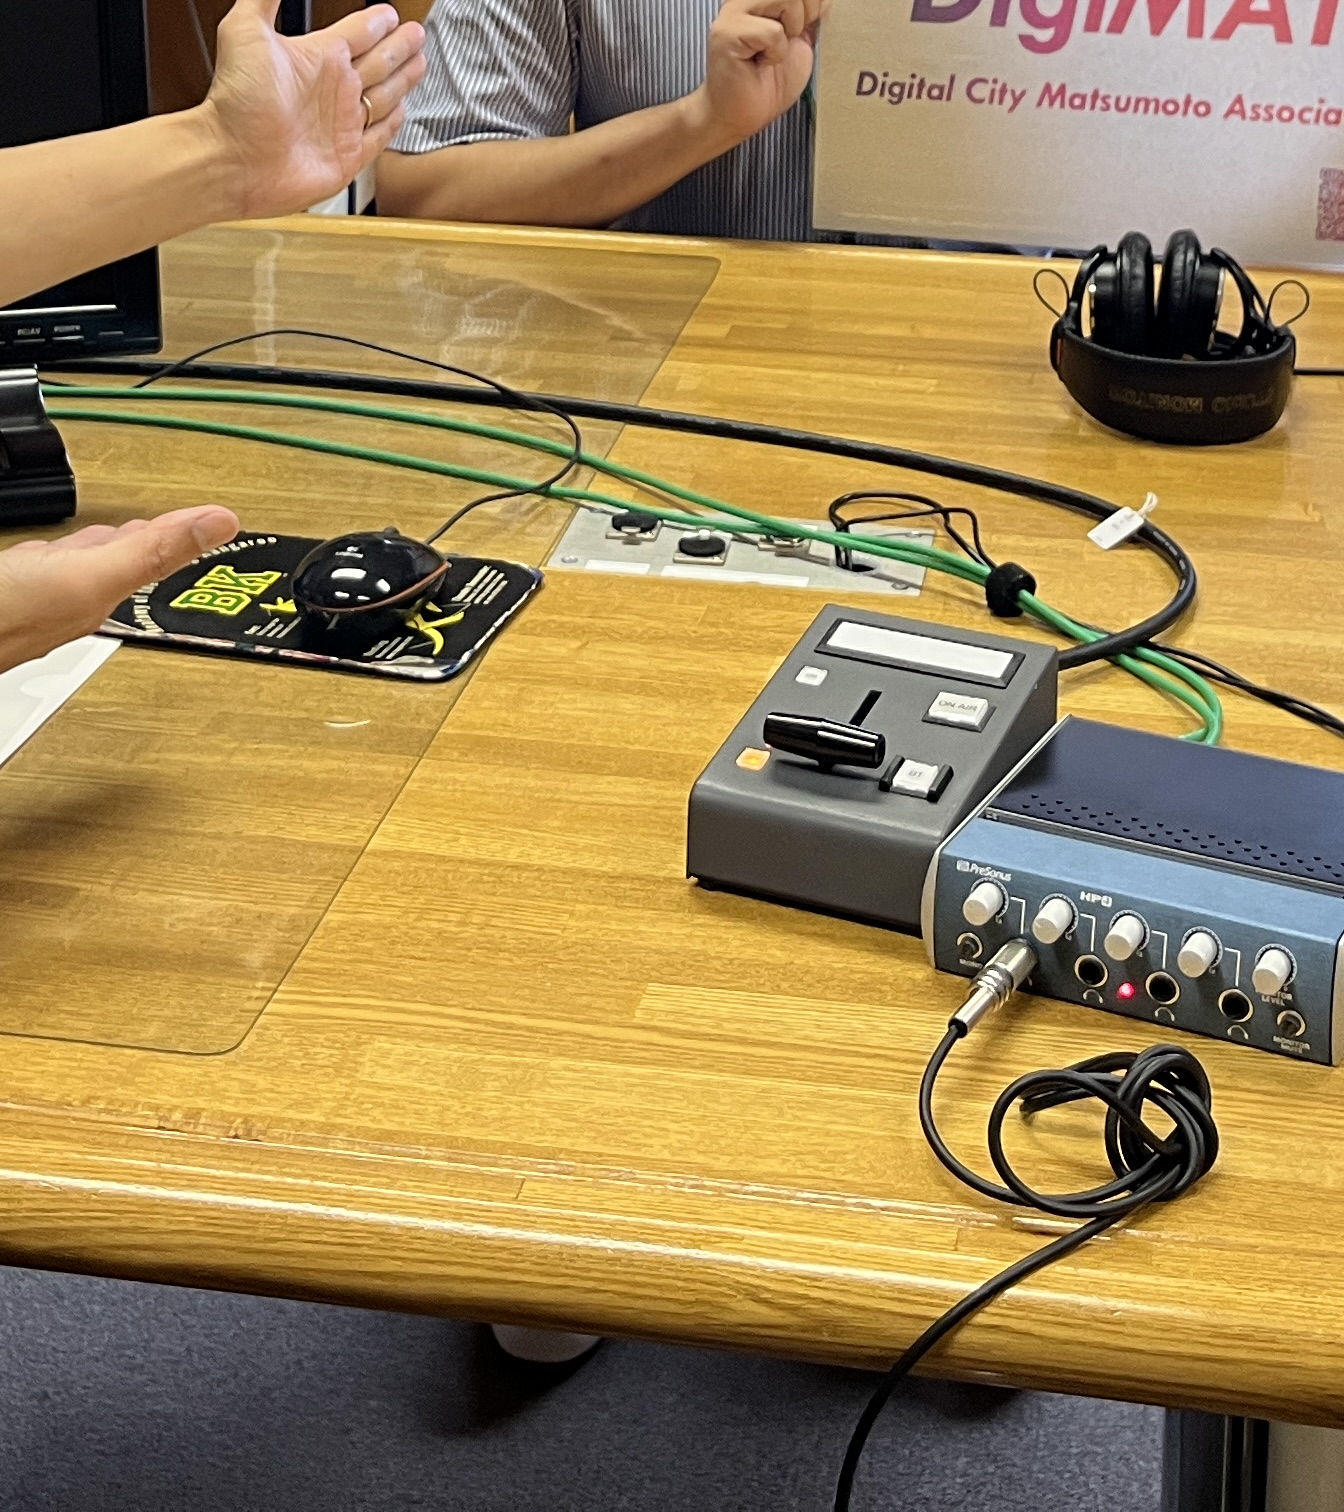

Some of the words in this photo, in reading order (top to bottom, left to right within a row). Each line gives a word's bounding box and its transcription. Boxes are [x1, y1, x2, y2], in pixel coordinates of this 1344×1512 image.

[856, 71, 955, 108] Digital
[964, 78, 1027, 114] City
[1036, 82, 1212, 119] Matsumoto
[169, 564, 282, 616] BK
[938, 699, 955, 708] ON
[957, 702, 978, 713] AIR
[969, 863, 1012, 882] PreSonus
